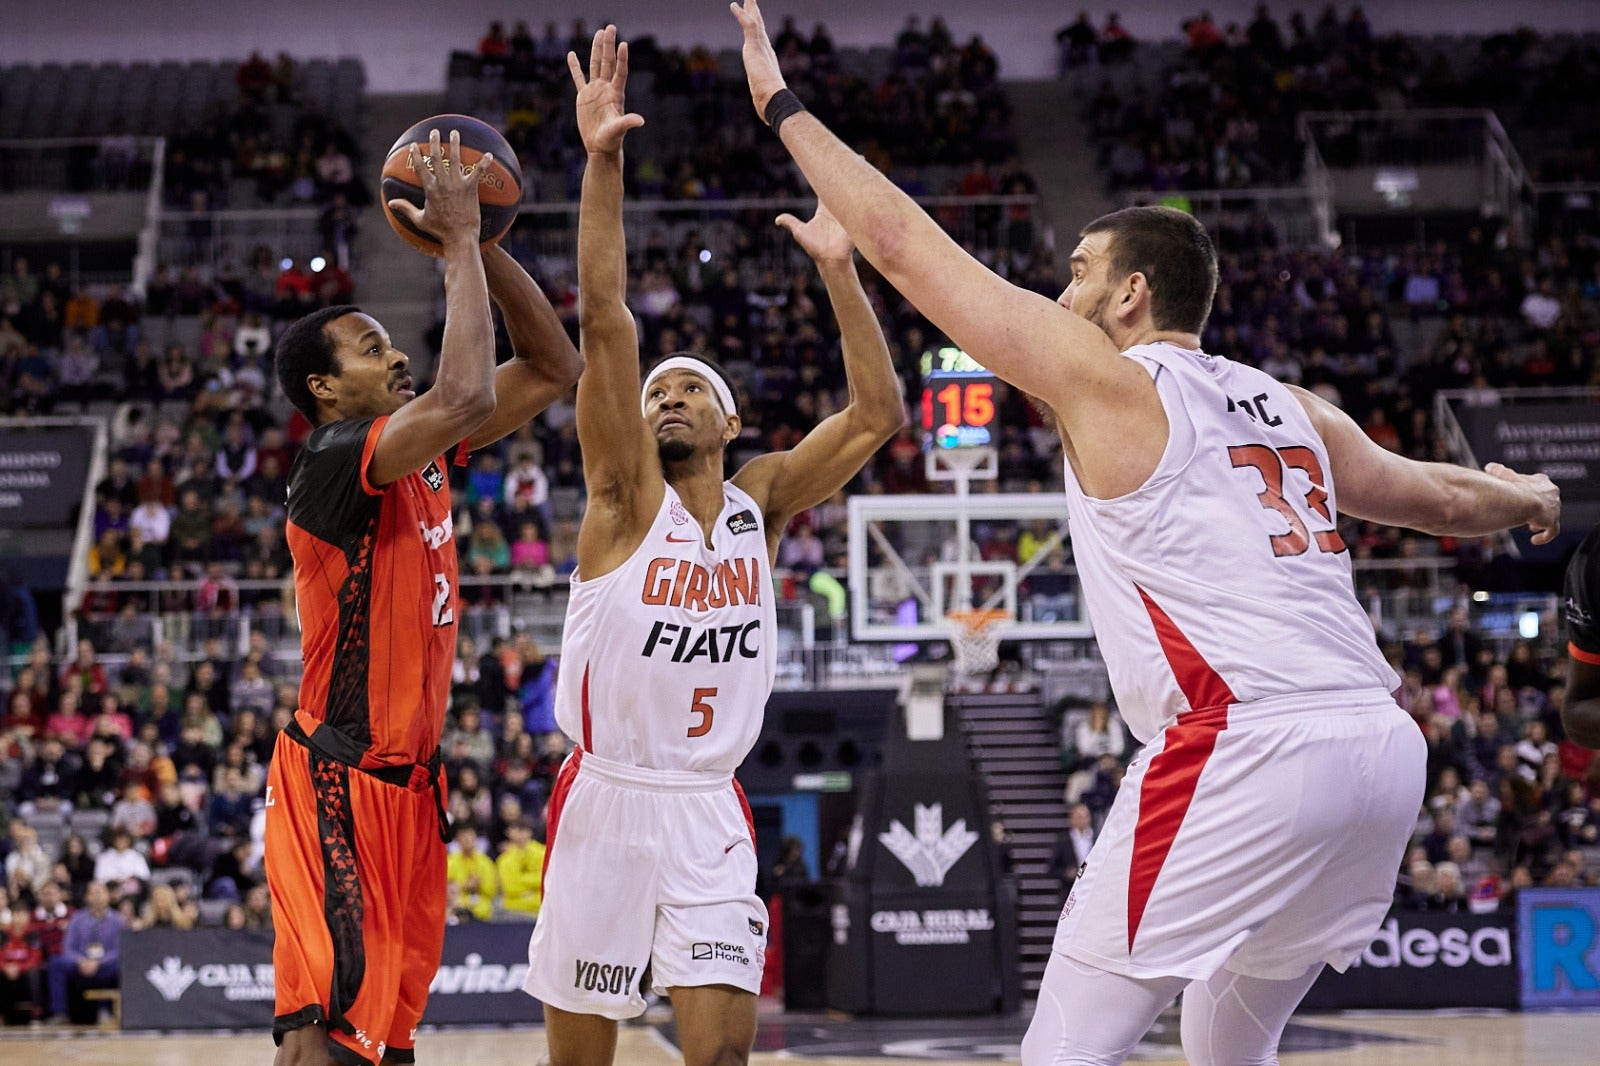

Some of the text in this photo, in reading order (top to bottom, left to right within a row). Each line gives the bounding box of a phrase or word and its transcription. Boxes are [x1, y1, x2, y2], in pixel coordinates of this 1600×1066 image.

[937, 383, 995, 427] 15
[1226, 443, 1348, 557] 33
[641, 556, 762, 613] GIRONA
[641, 618, 761, 664] FIATC
[686, 687, 718, 738] 5
[715, 941, 745, 954] Kave
[715, 951, 750, 966] Home
[1351, 917, 1512, 968] desa
[574, 959, 637, 996] YOSOY
